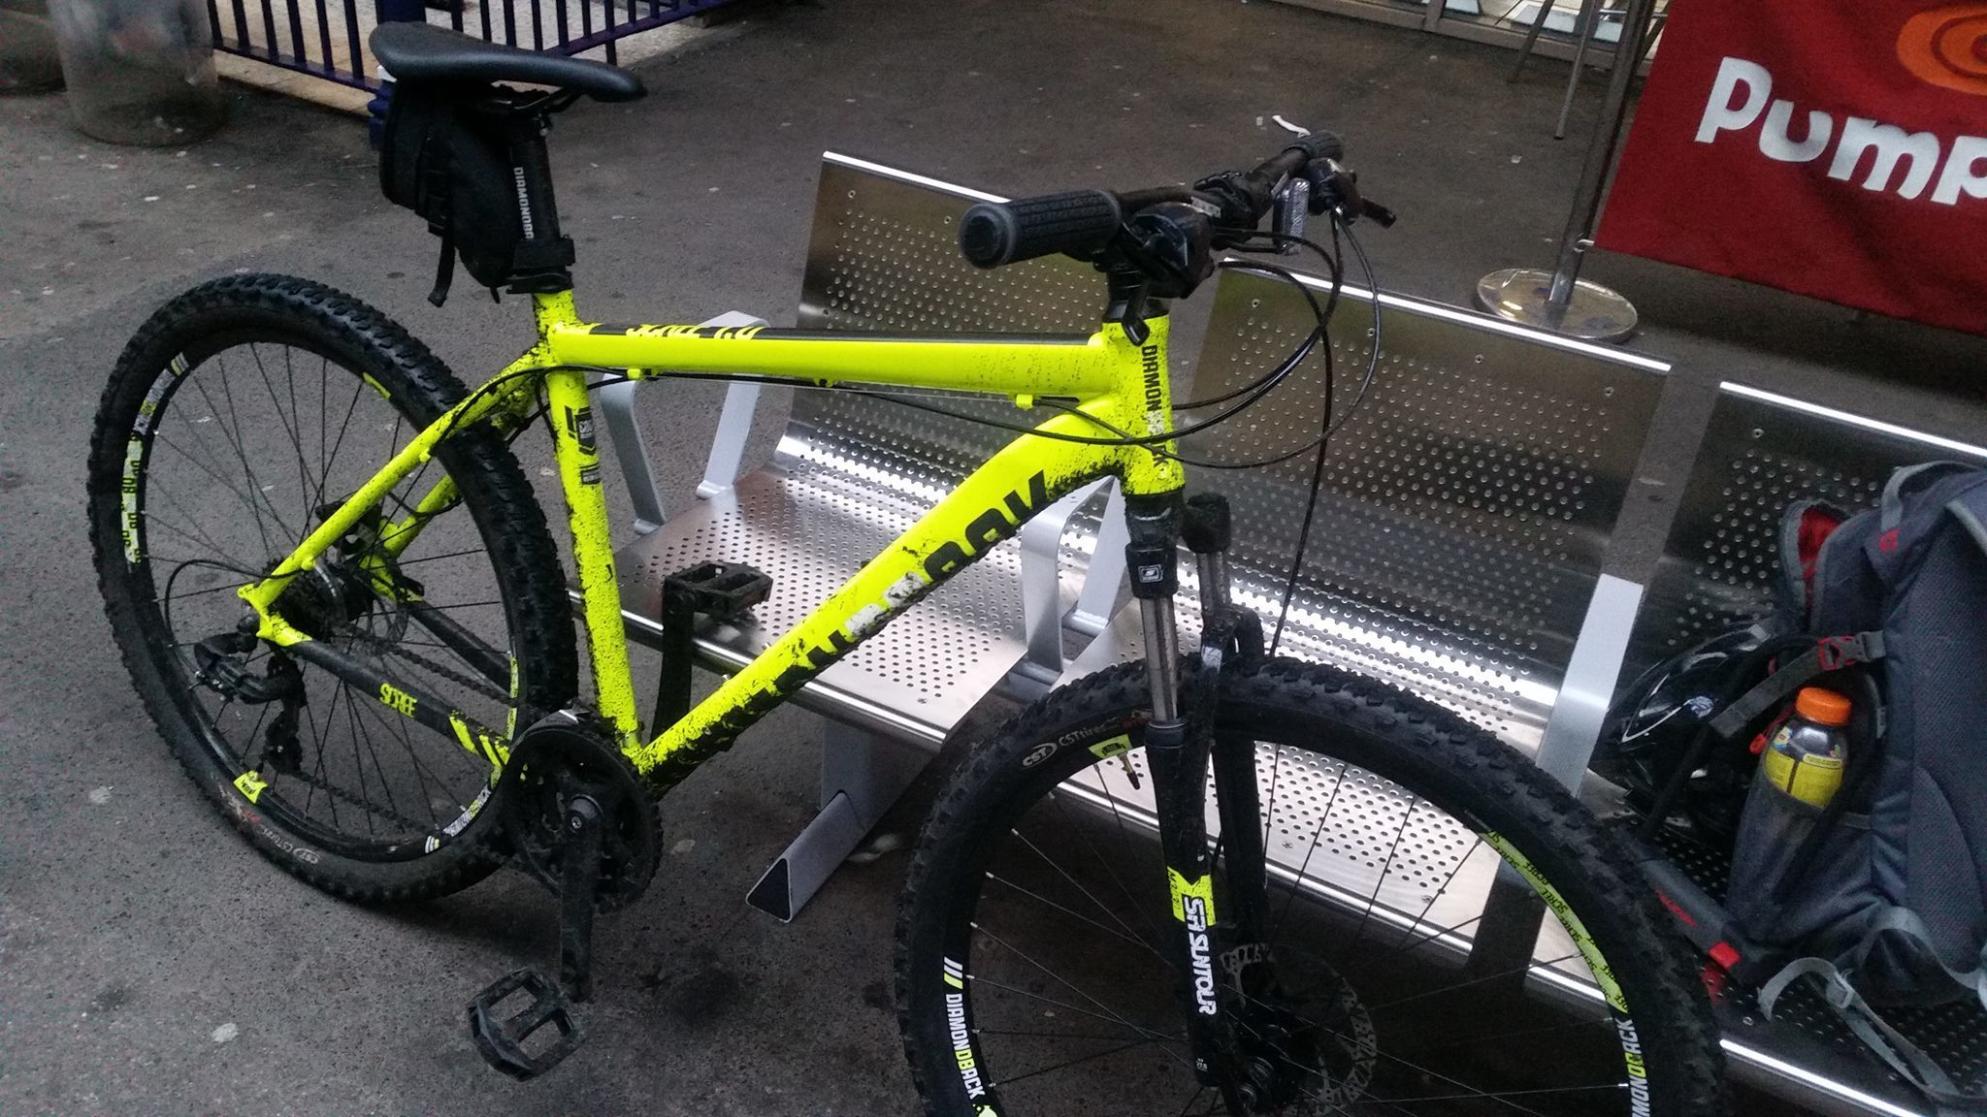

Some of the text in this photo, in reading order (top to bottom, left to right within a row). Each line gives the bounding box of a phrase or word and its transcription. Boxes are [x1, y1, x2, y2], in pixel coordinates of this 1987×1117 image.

[1023, 747, 1048, 767] CST
[1183, 896, 1217, 1016] SR SUNTOUR
[945, 993, 986, 1100] DIAMONDBACK
